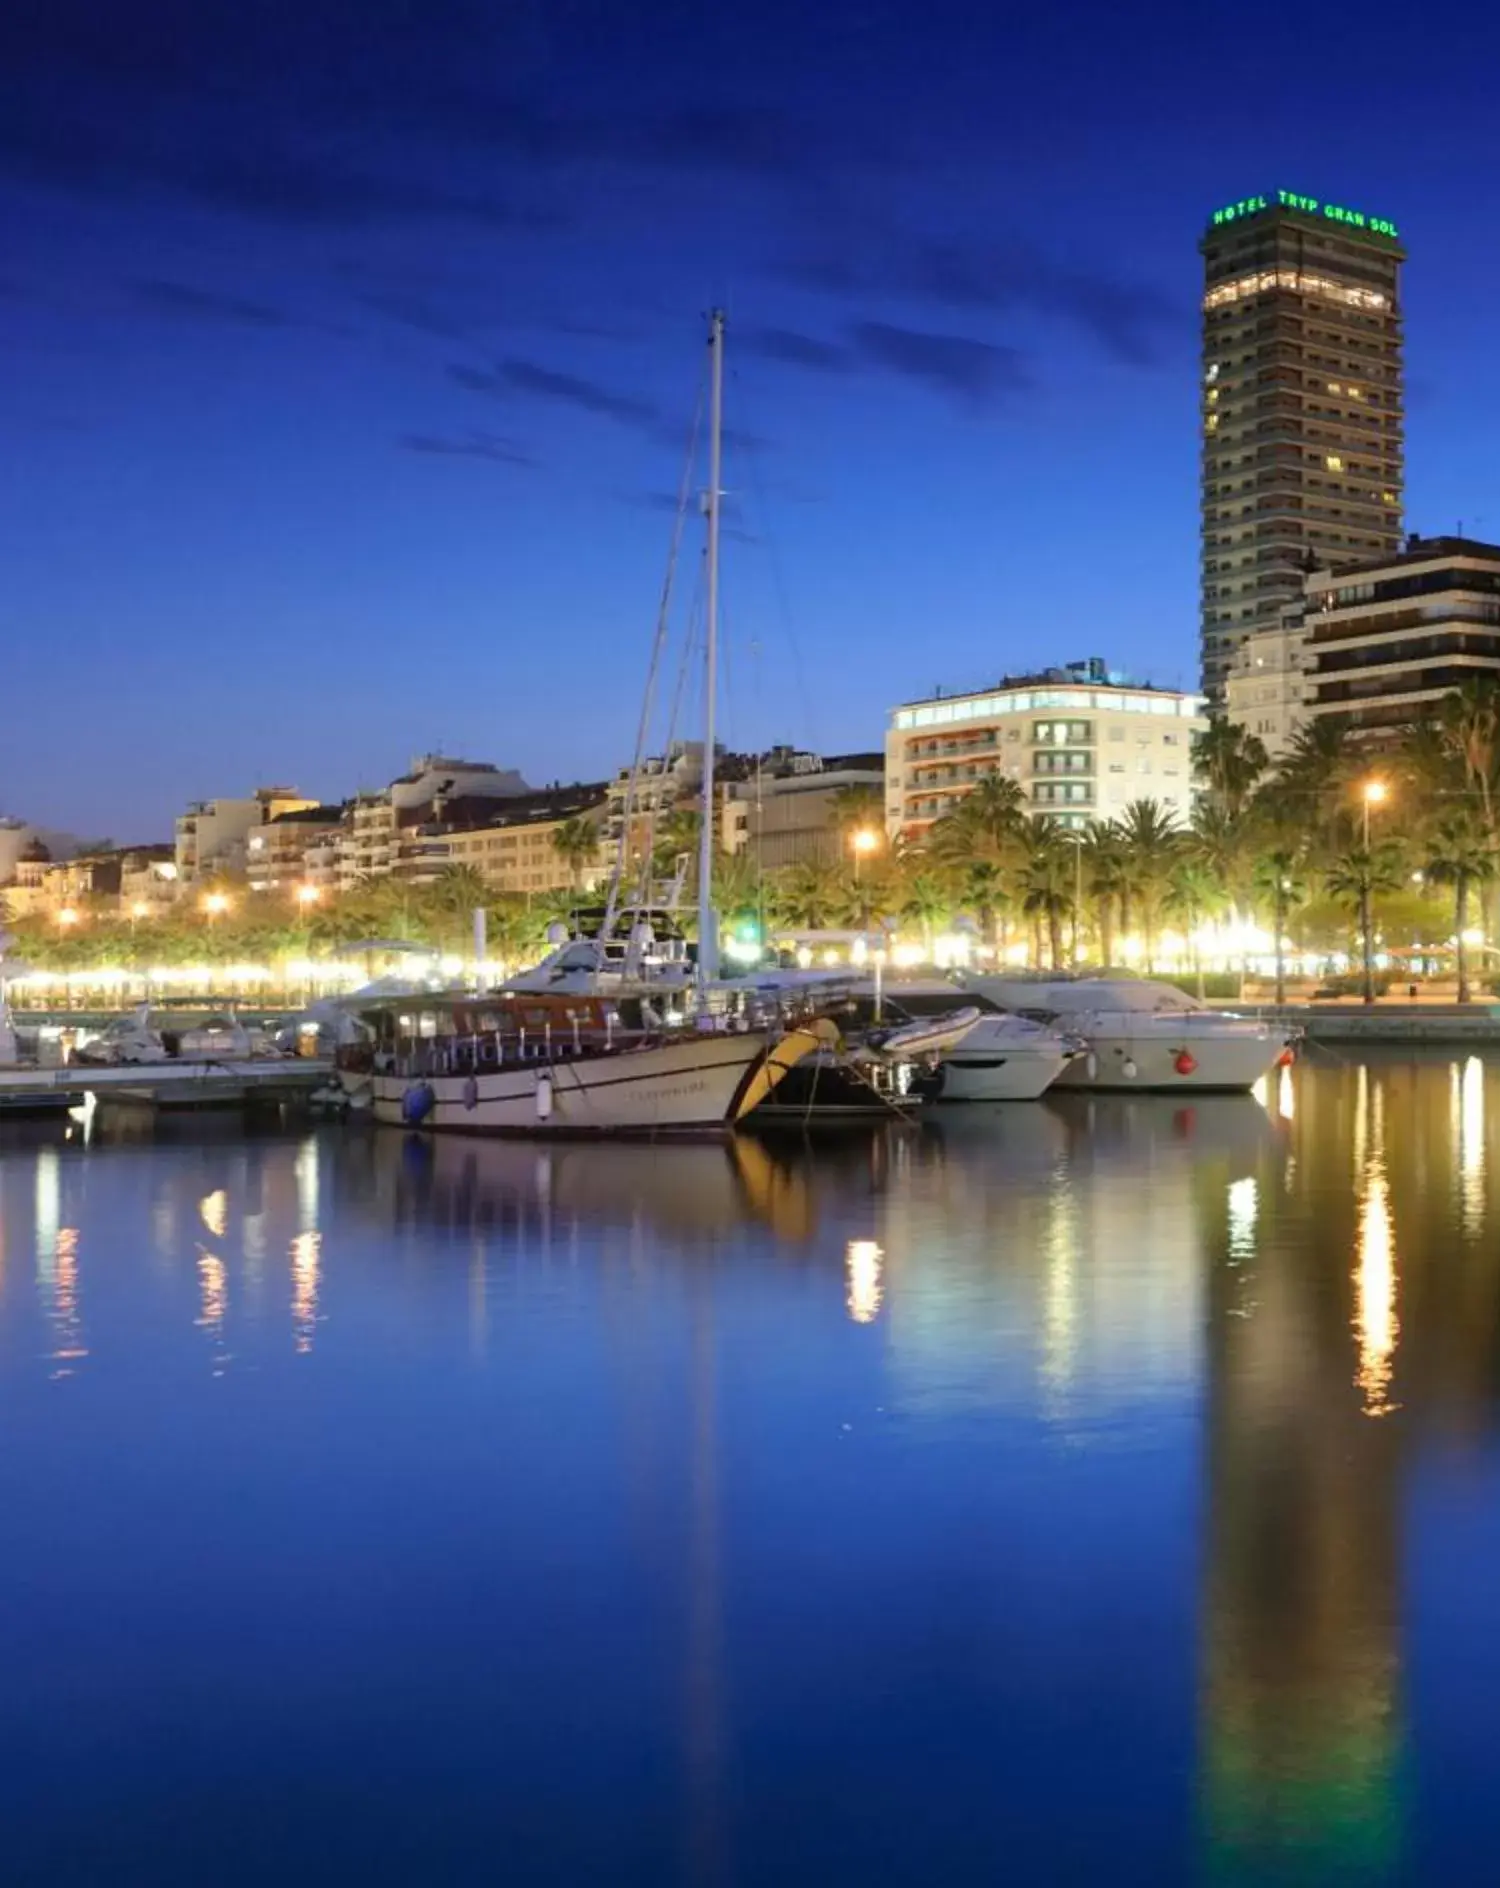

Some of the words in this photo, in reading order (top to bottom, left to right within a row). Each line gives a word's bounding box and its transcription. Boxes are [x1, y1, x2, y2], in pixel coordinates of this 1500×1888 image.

[1214, 196, 1267, 225] HOTEL
[1278, 189, 1318, 212] TRYP
[1323, 204, 1365, 226] GRAN
[1369, 217, 1398, 237] SOL
